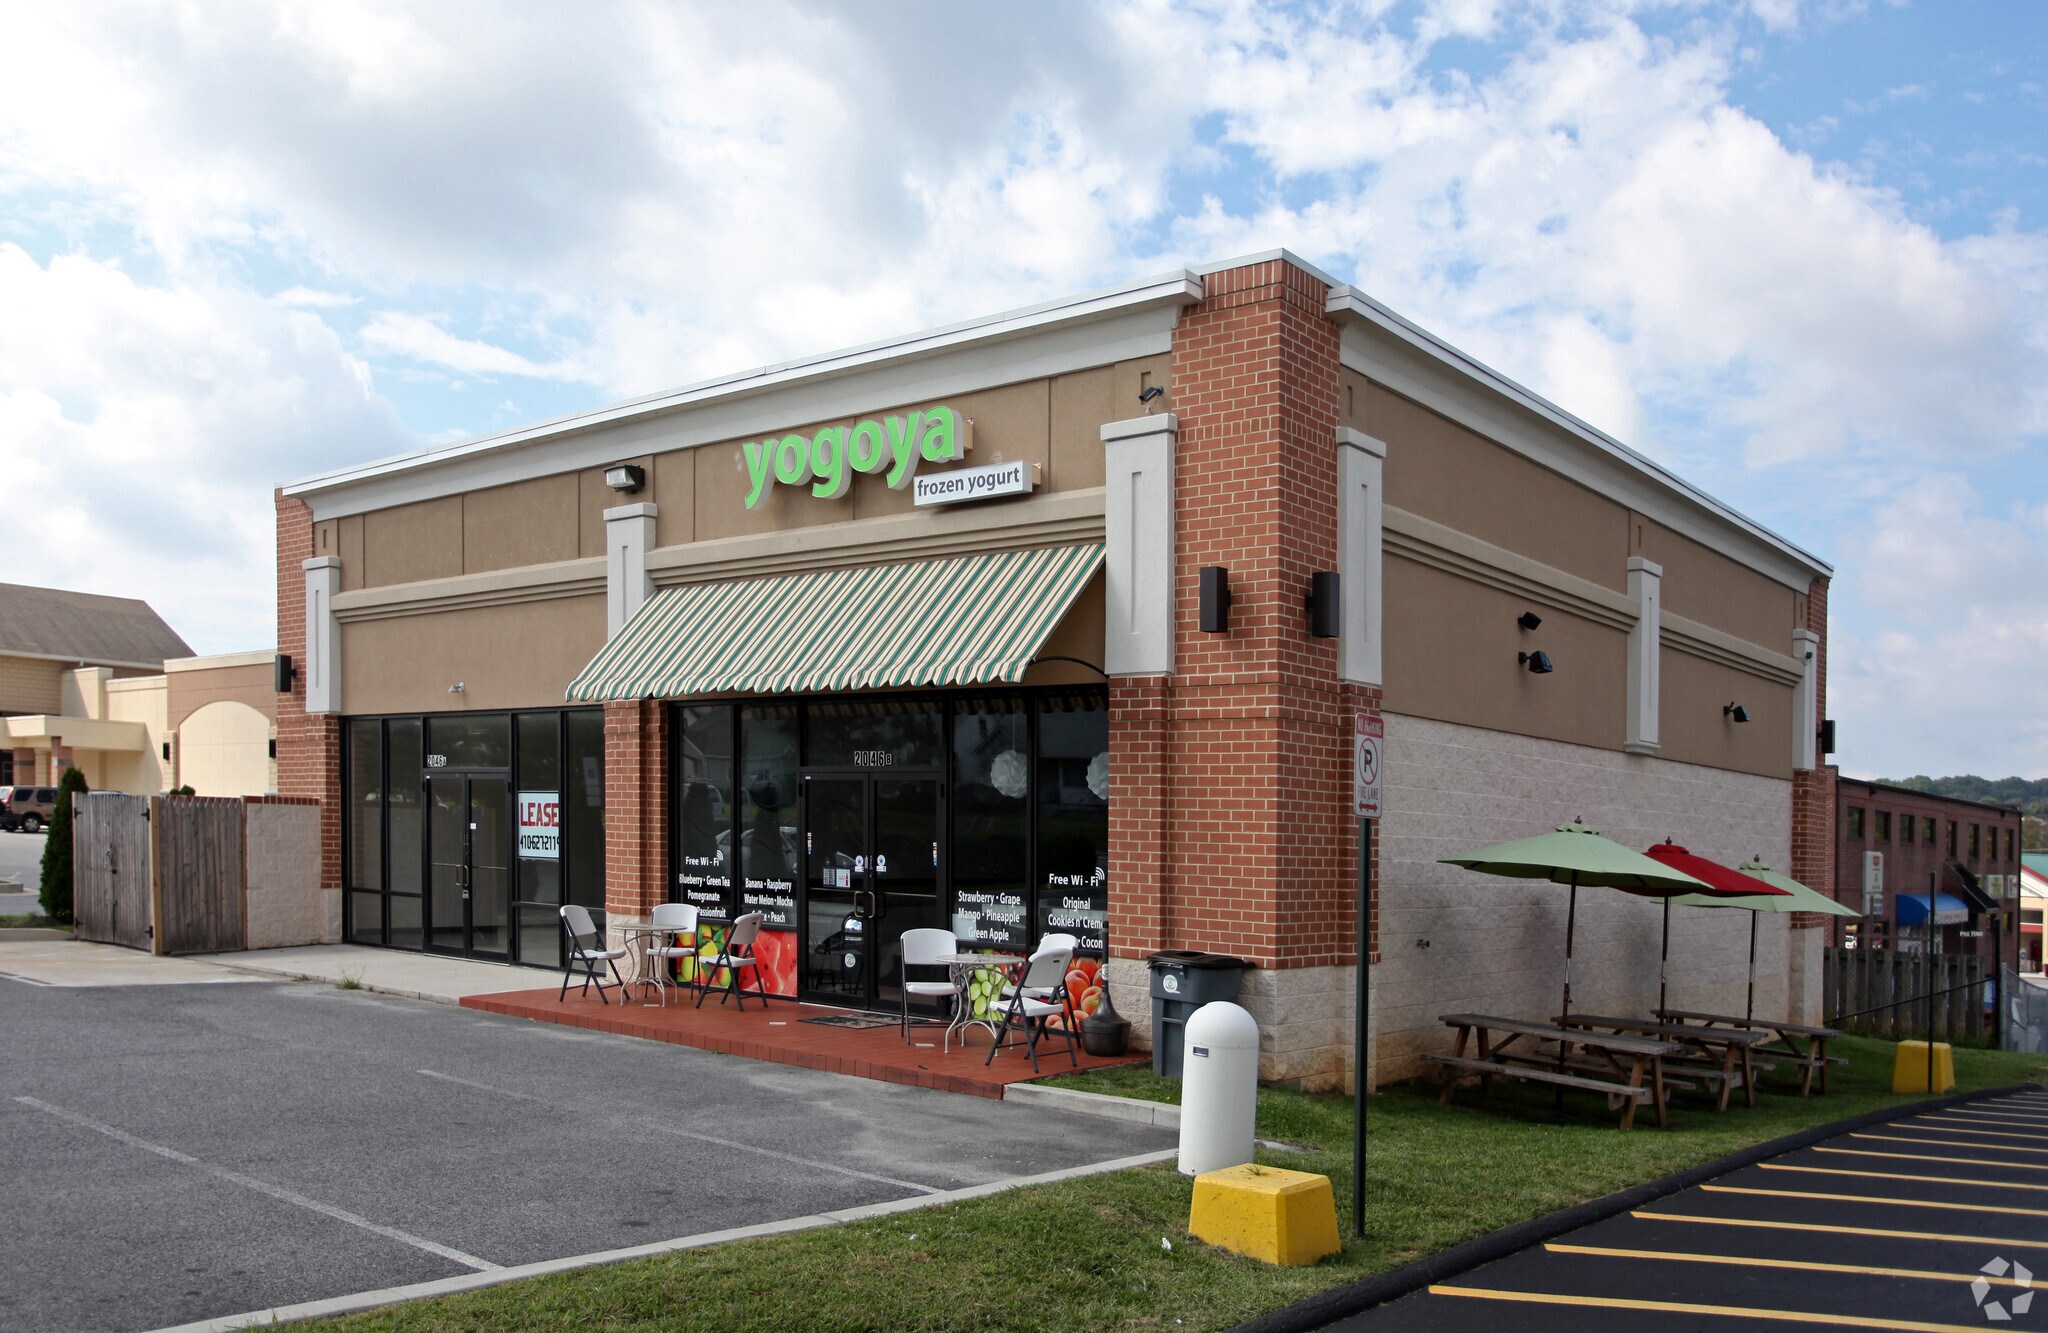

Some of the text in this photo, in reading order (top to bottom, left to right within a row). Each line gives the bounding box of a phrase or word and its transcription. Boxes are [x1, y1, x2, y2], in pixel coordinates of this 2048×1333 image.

[742, 406, 957, 510] yogoya
[917, 467, 1020, 496] frozen yogurt
[520, 802, 560, 827] LEASE
[685, 856, 700, 866] Free
[679, 873, 731, 888] Blueberry Green Tea
[745, 877, 792, 893] Banana Raspberry
[1049, 873, 1069, 885] Free
[687, 889, 721, 903] Pomegranate
[743, 893, 793, 907] Water Melon Mocha
[958, 890, 1021, 908] Strawberry Grape
[1062, 896, 1091, 912] Original
[770, 911, 786, 923] Peach
[958, 907, 1020, 925] Mango Pineapple
[1048, 914, 1075, 928] Cookies
[968, 926, 1010, 943] Green Apple
[1081, 935, 1103, 949] Cocon
